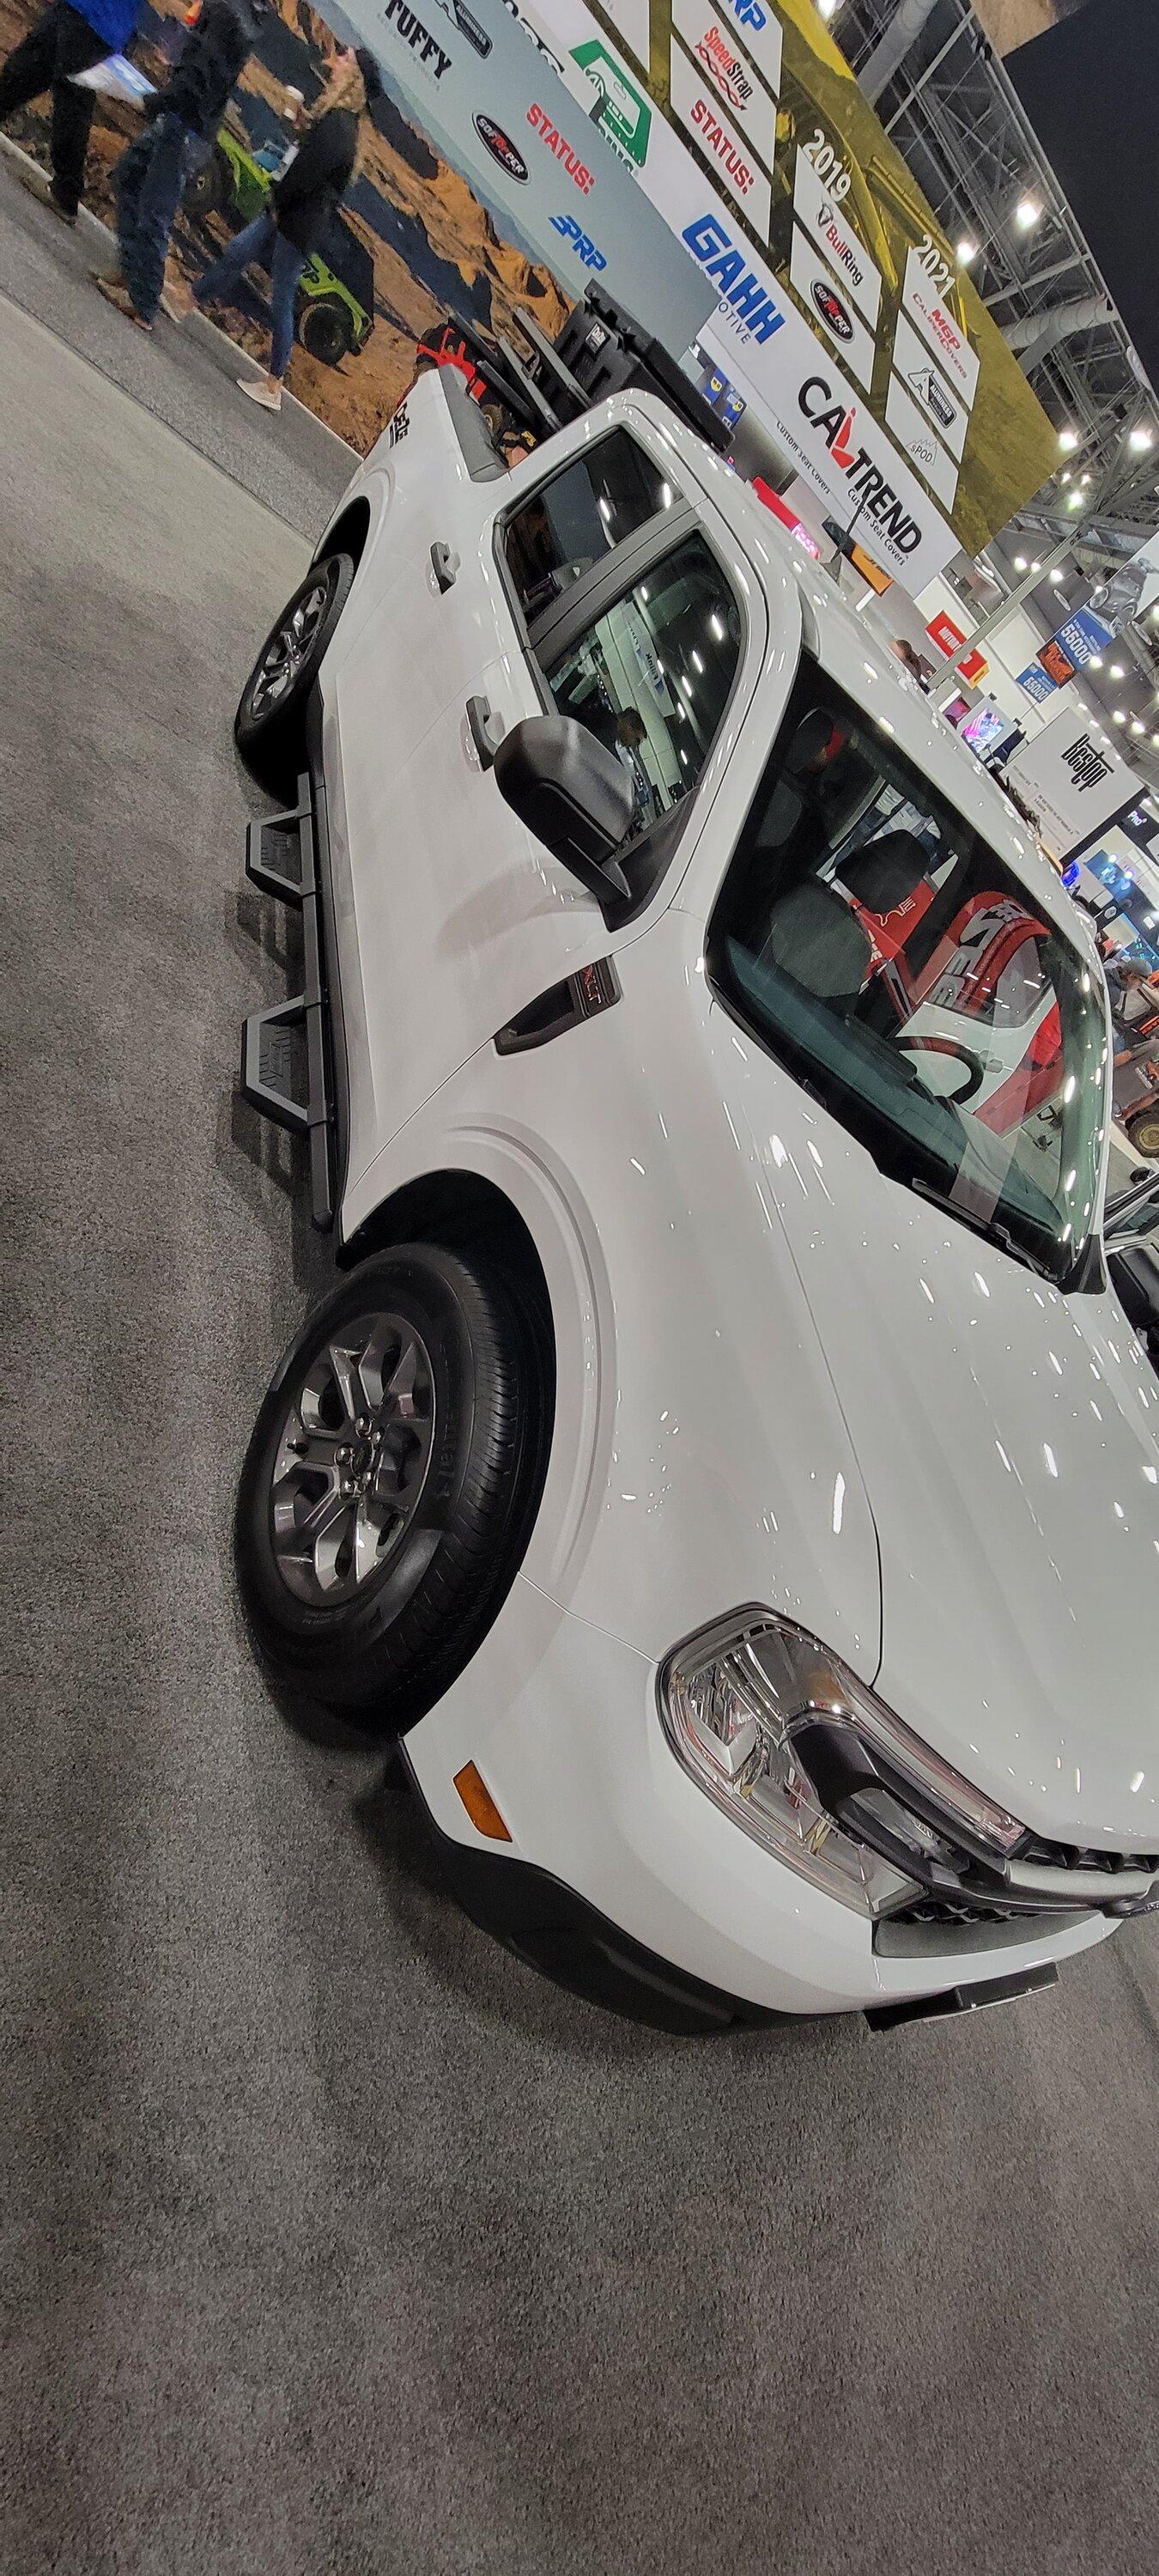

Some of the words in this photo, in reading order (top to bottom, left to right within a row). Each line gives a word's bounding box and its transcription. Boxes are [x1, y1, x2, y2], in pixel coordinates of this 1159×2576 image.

[385, 0, 452, 79] TUFFY
[728, 0, 766, 31] RP
[704, 26, 754, 102] SpeedStrap
[803, 129, 852, 202] 2019
[548, 215, 607, 272] PRP
[824, 225, 865, 287] BullRing
[913, 234, 956, 299] 2021
[682, 214, 786, 345] GAHH
[718, 301, 751, 345] OTIVE
[931, 308, 961, 349] MGP
[929, 384, 953, 417] ALUMINESS
[847, 489, 871, 525] Cusom
[869, 518, 888, 543] Seat
[884, 538, 906, 567] Covers
[1061, 733, 1115, 793] Bestop
[581, 964, 603, 1005] XLT
